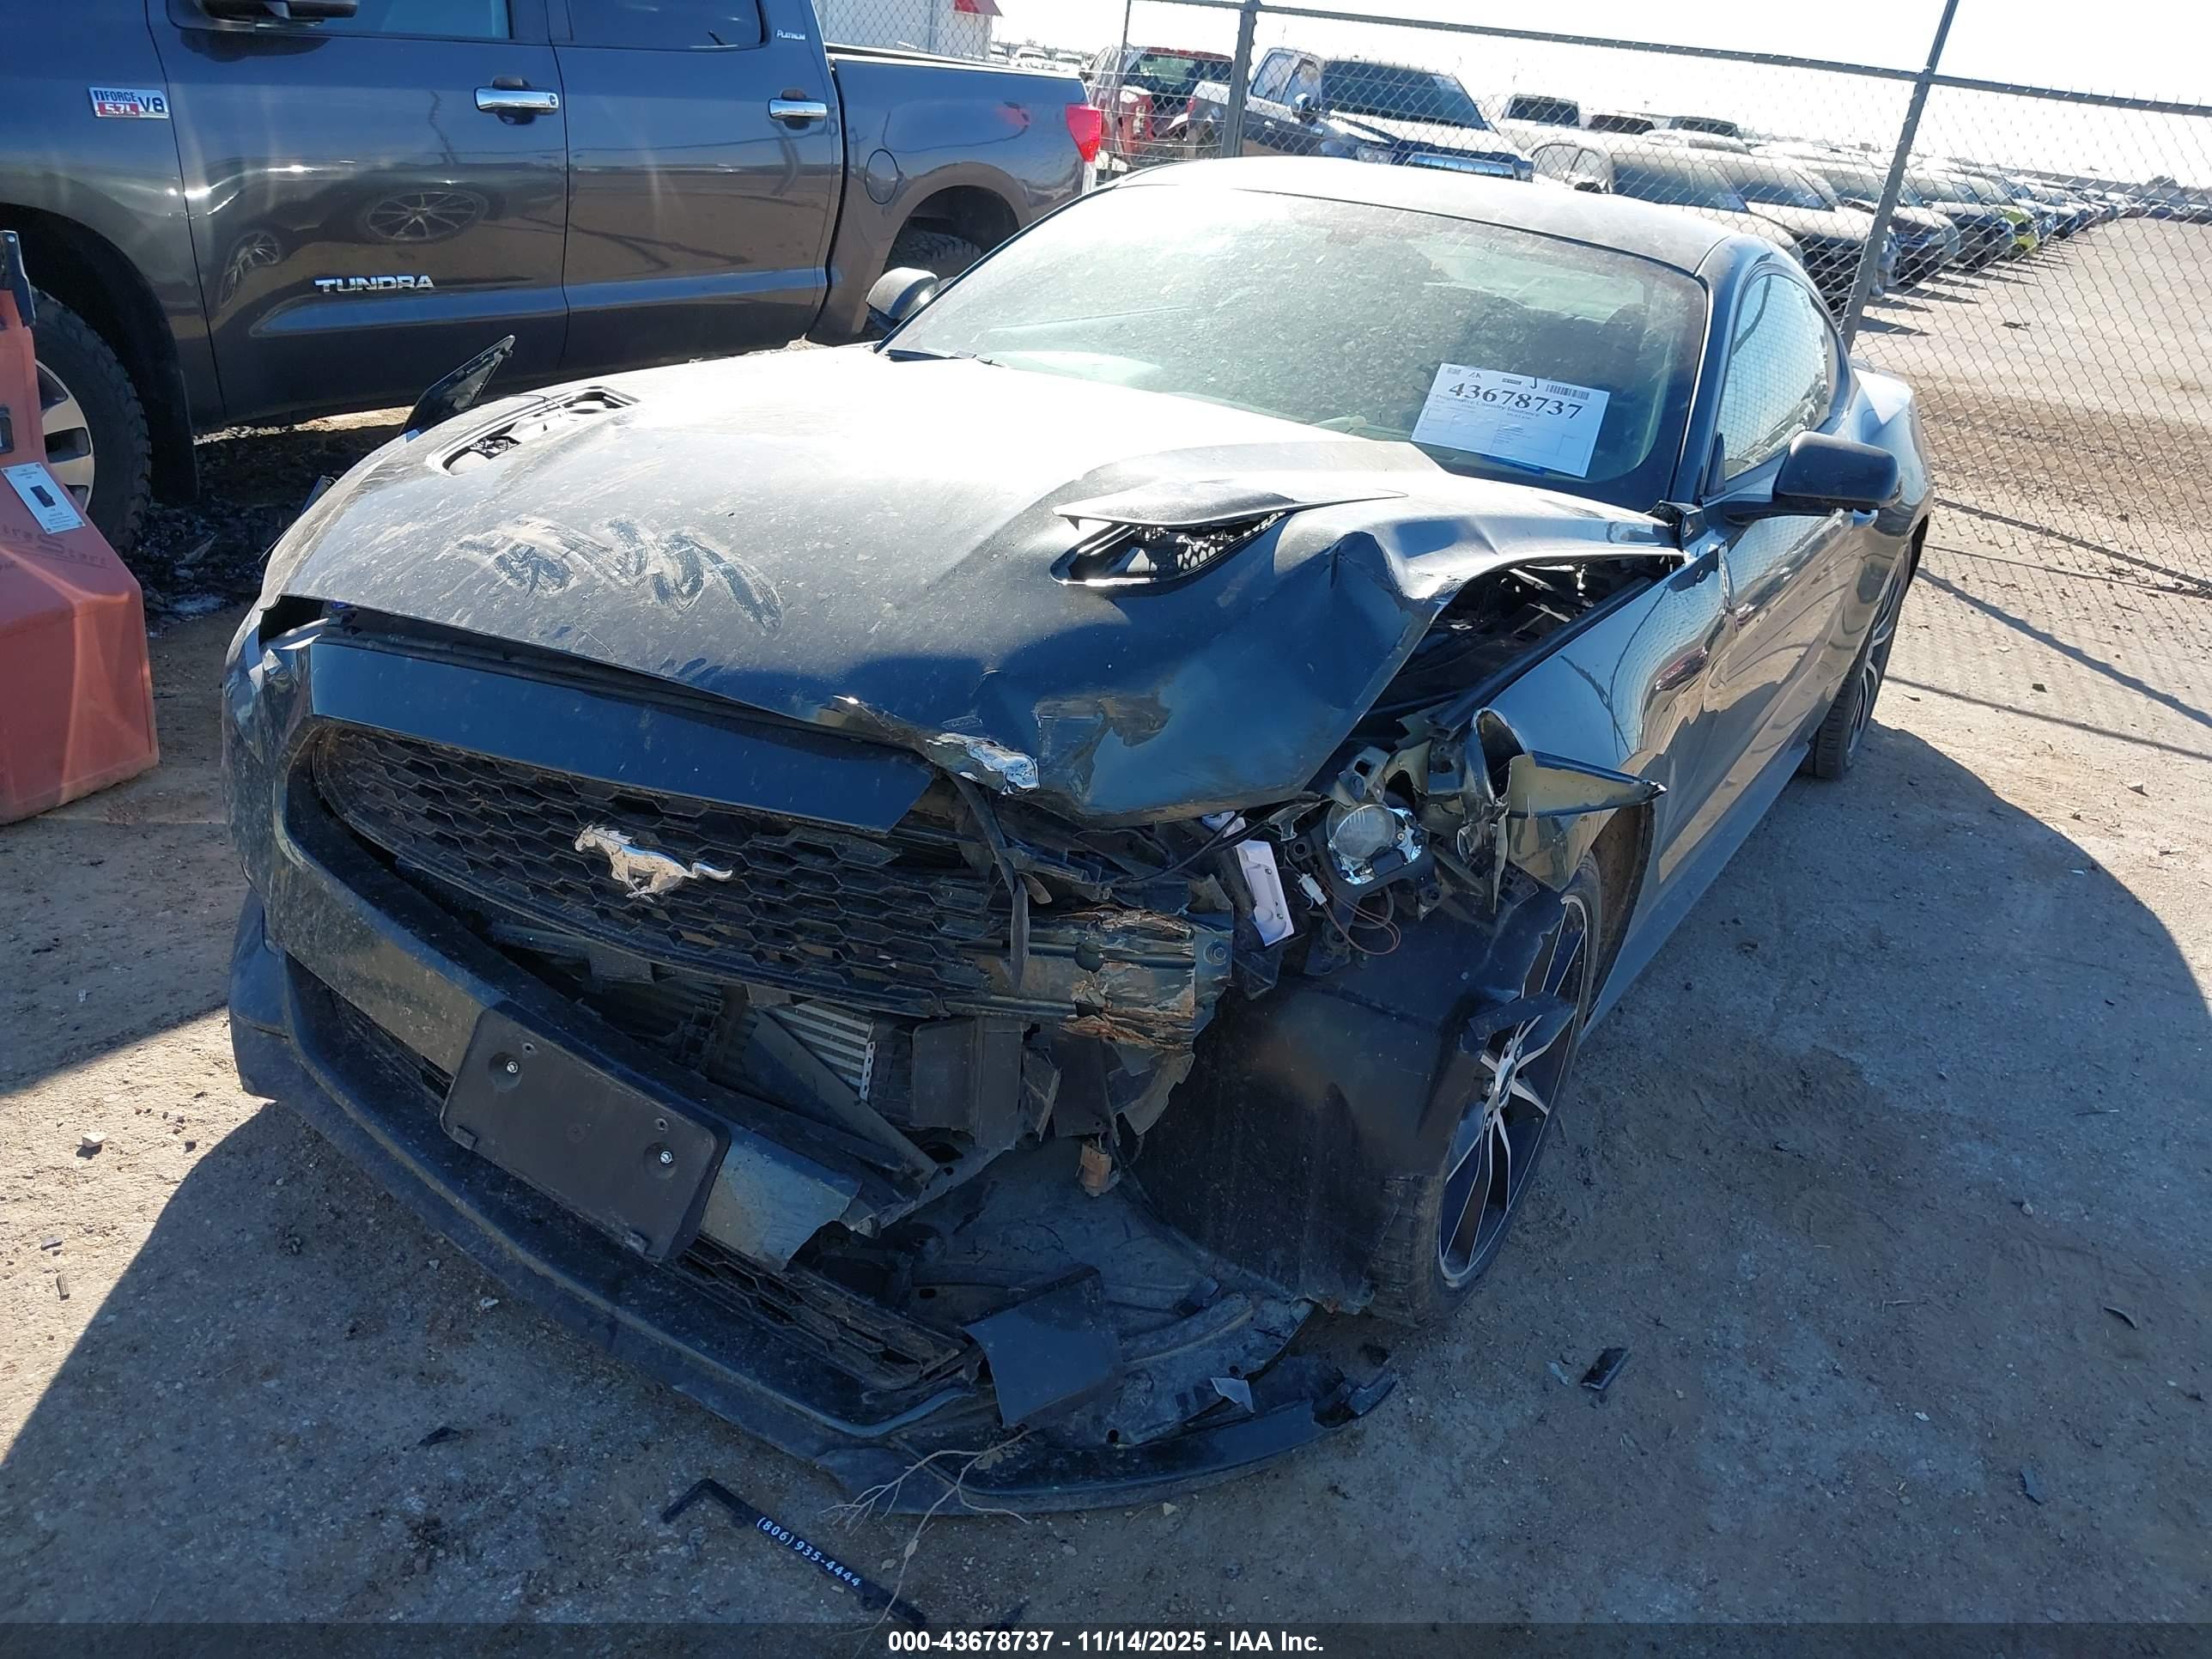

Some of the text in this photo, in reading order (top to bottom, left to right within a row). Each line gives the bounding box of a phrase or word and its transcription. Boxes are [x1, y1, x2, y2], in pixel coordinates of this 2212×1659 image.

[138, 96, 164, 113] V8
[314, 274, 434, 293] TUNDRA
[1449, 382, 1583, 420] 43678737
